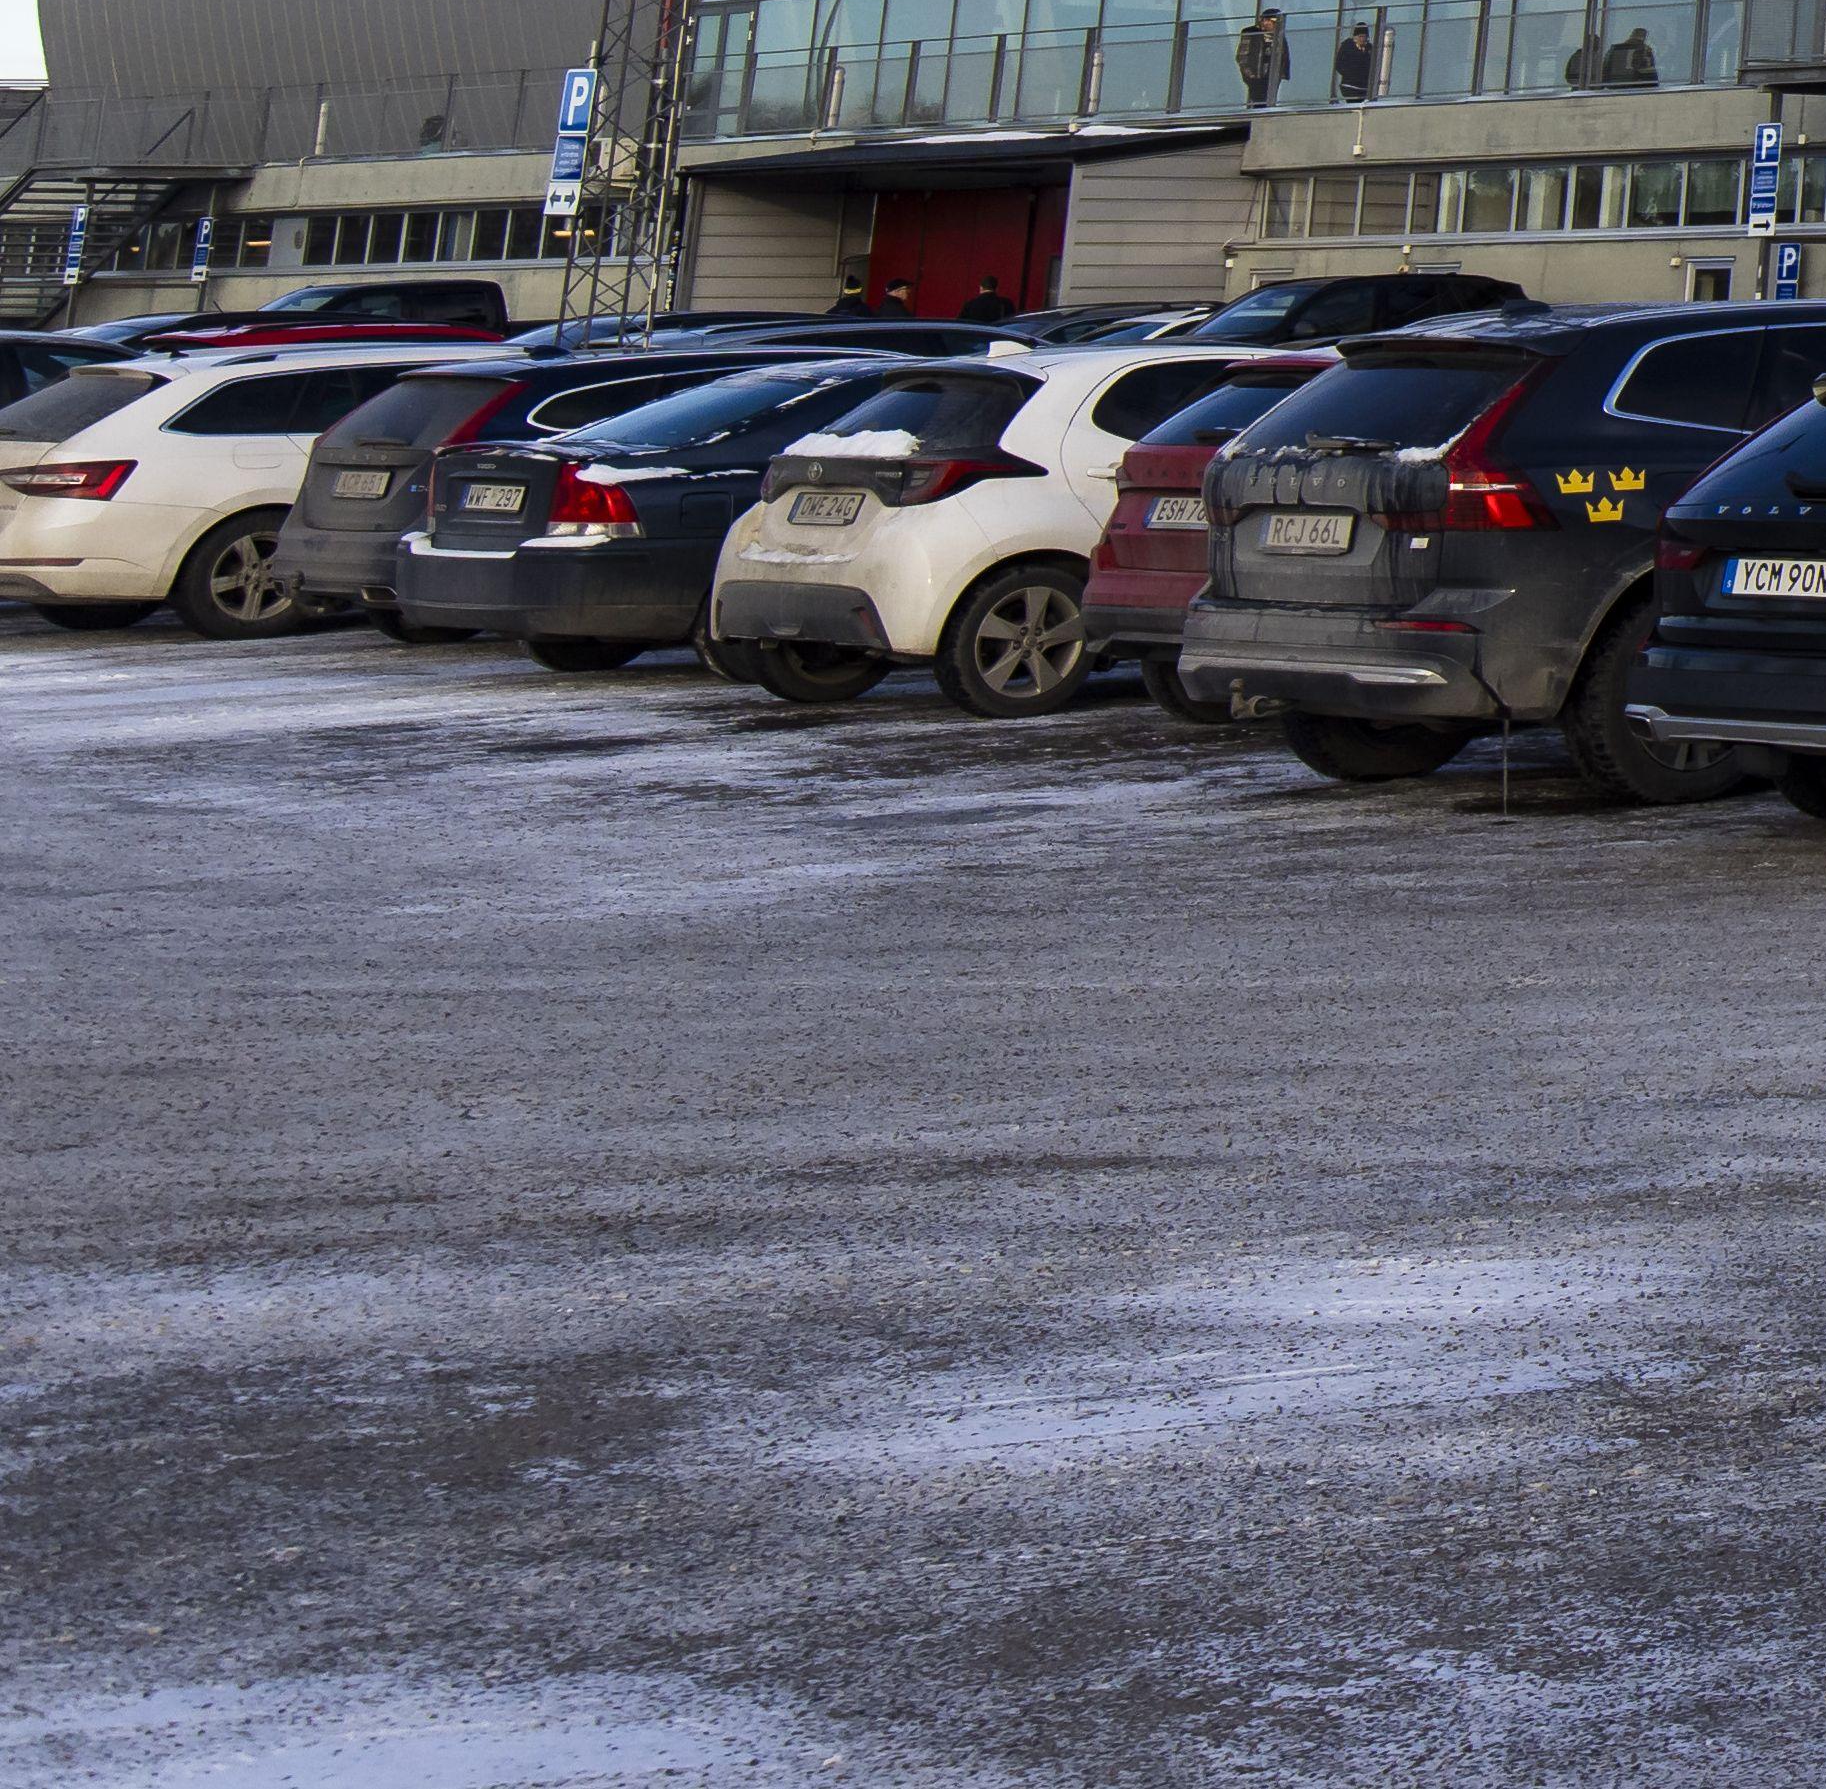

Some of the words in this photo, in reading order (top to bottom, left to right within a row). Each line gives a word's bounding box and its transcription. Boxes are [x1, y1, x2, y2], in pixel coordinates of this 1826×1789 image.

[566, 76, 589, 126] P
[1761, 128, 1777, 160] P
[75, 207, 85, 231] P
[200, 220, 211, 243] P
[1782, 247, 1798, 278] P
[468, 486, 489, 508] WWF
[495, 487, 521, 508] 297
[801, 496, 829, 517] OWE
[1157, 499, 1186, 521] ESH
[1272, 517, 1305, 545] RCJ
[1308, 518, 1340, 545] 66L
[1744, 562, 1784, 592] YCM
